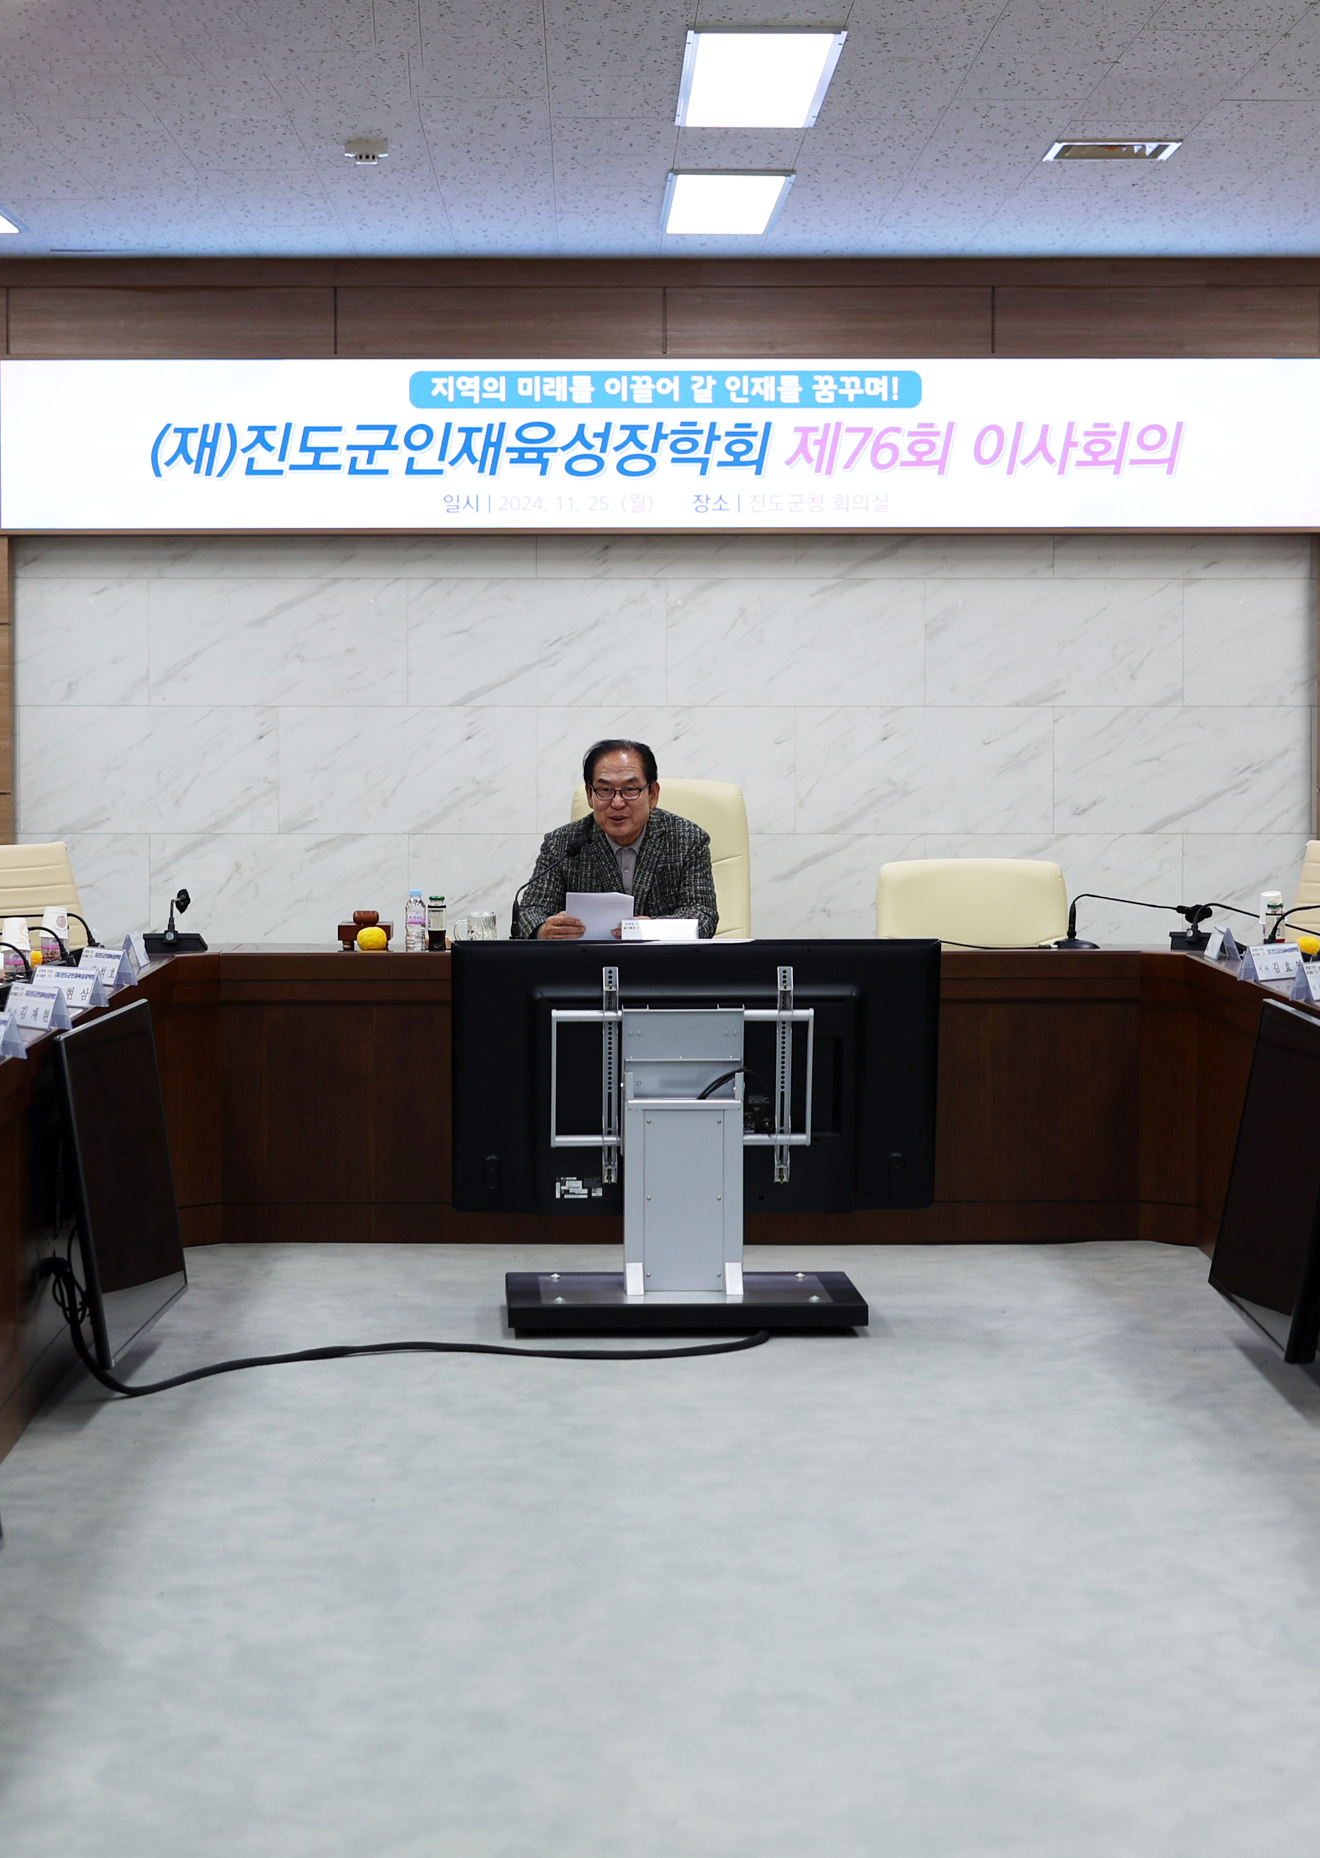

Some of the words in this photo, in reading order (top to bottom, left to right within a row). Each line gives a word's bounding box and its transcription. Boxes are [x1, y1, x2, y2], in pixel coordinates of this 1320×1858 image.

[430, 375, 507, 403] 지역의
[517, 375, 596, 403] 미래를
[603, 375, 681, 403] 이끌어
[690, 375, 718, 403] 갈
[724, 375, 804, 403] 인재를
[811, 375, 900, 403] 꿈꾸며!
[150, 420, 773, 479] (재)진도군인재육성장학회
[784, 421, 956, 476] 제76회
[972, 421, 1184, 476] 이사회의
[443, 494, 480, 513] 일시
[498, 495, 547, 511] 2024.
[556, 496, 580, 511] 11.
[588, 496, 614, 511] 25.
[621, 494, 653, 514] (월)
[692, 494, 731, 514] 장소
[748, 493, 824, 513] 진도군청
[832, 493, 888, 513] 회의실
